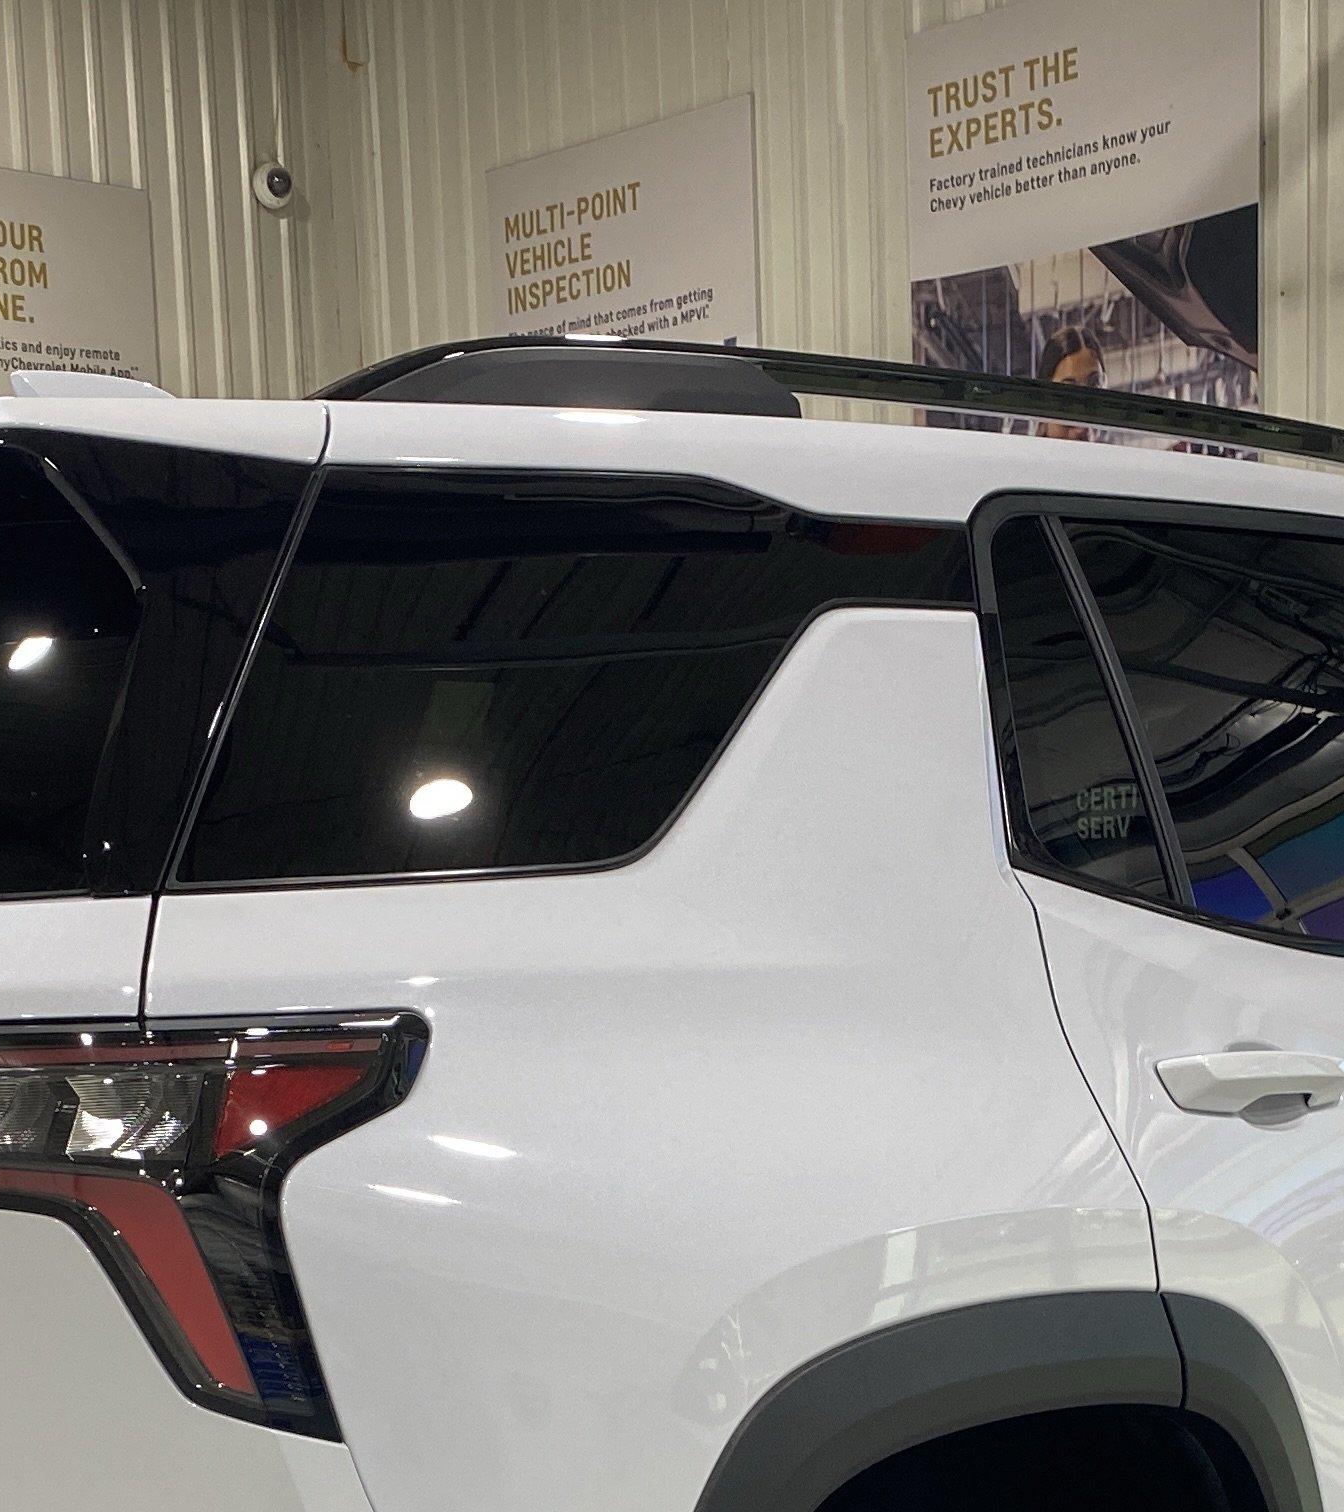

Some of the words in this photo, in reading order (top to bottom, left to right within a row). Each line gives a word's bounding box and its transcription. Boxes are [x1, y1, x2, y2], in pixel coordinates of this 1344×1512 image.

[927, 64, 1016, 118] TRUST
[1023, 47, 1079, 91] THE
[929, 97, 1063, 159] EXPERTS.
[929, 170, 975, 193] Factory
[978, 157, 1022, 182] trained
[1026, 139, 1099, 170] technicians
[1102, 129, 1137, 150] know
[1140, 119, 1172, 144] your
[929, 196, 967, 213] Chevy
[968, 181, 1012, 205] vehicle
[1015, 172, 1055, 194] better
[1057, 163, 1087, 184] than
[1090, 152, 1141, 176] anyone.
[504, 182, 641, 243] MULTI-POINT
[505, 232, 592, 279] VEHICLE
[508, 259, 631, 315] INSPECTION
[556, 320, 566, 334] of
[568, 315, 591, 331] mind
[593, 311, 614, 326] that
[616, 304, 647, 321] comes
[650, 298, 674, 313] from
[676, 287, 713, 310] getting
[21, 341, 42, 354] and
[46, 343, 76, 360] enjoy
[79, 348, 120, 361] remote
[647, 315, 670, 331] with
[672, 317, 678, 327] a
